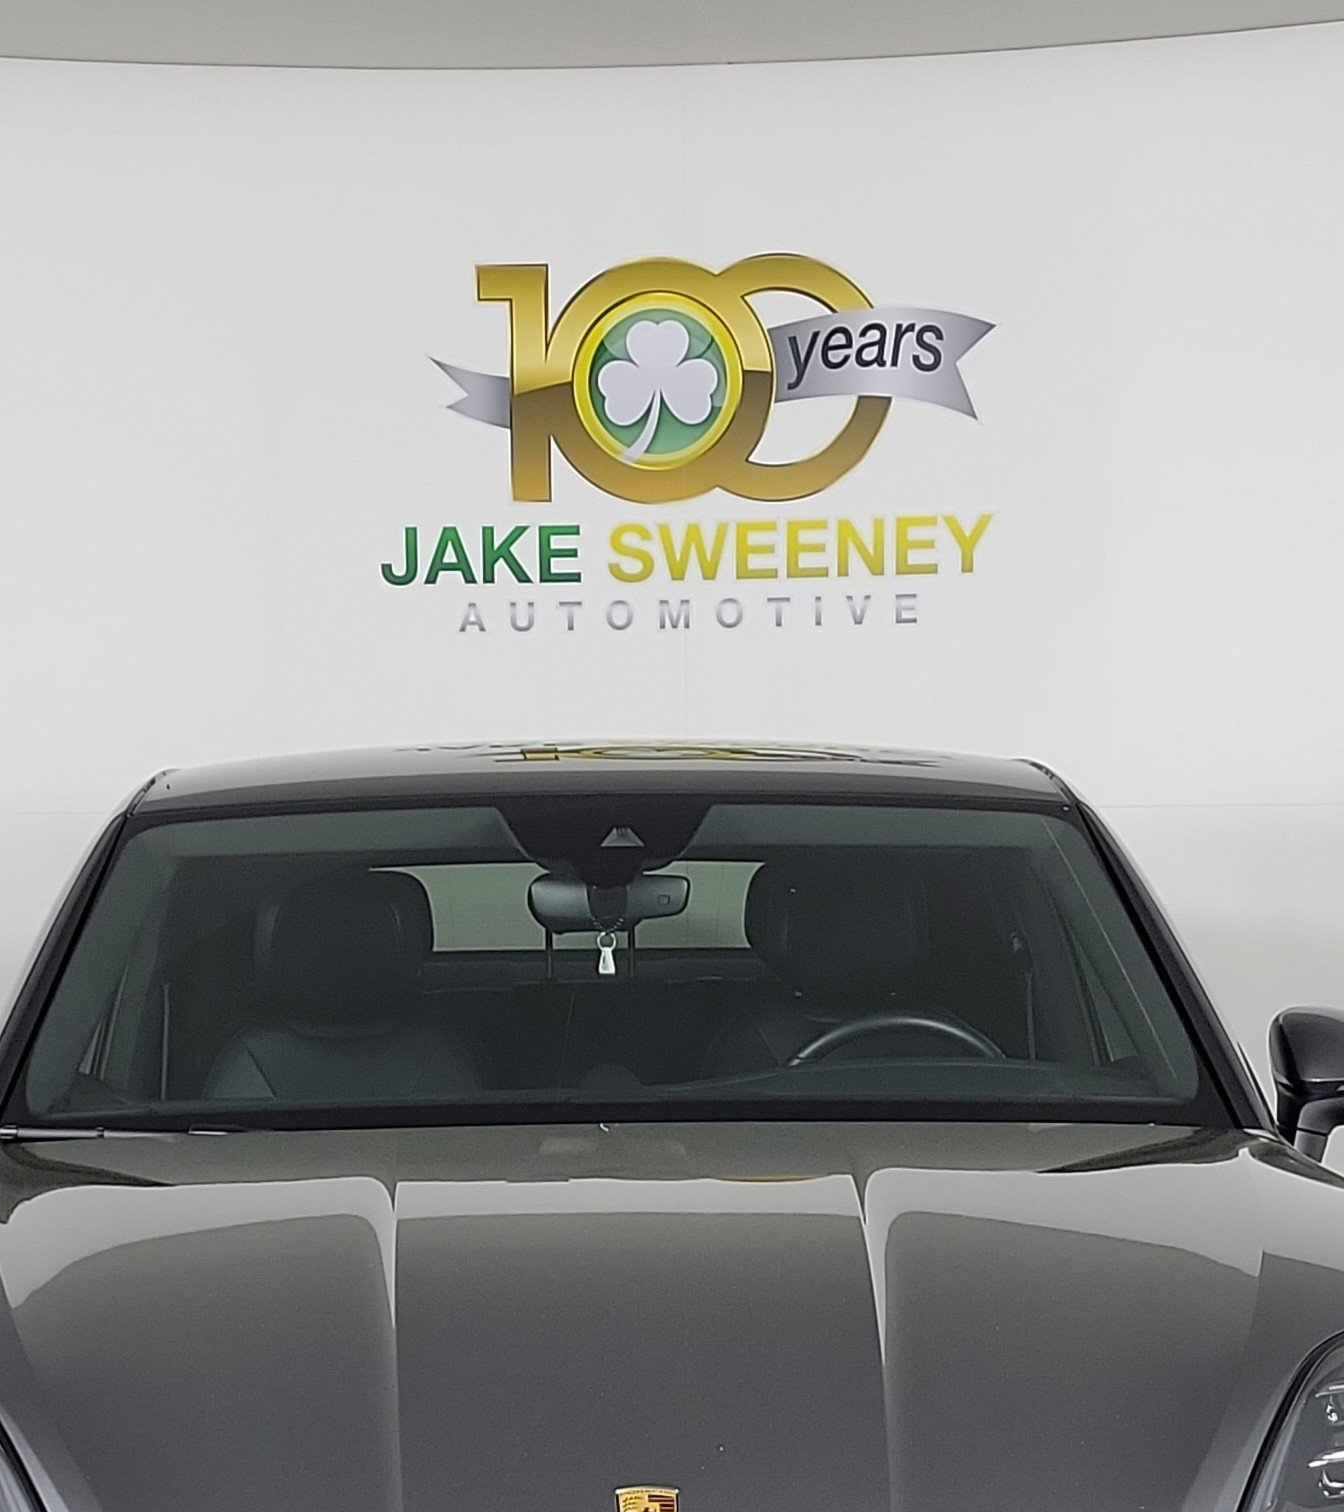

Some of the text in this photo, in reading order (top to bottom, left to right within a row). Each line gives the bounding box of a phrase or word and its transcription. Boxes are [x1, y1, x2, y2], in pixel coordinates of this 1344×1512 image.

[476, 253, 944, 504] 100 years
[381, 513, 993, 586] JAKE SWEENEY
[460, 593, 918, 633] AUTOMOTIVE
